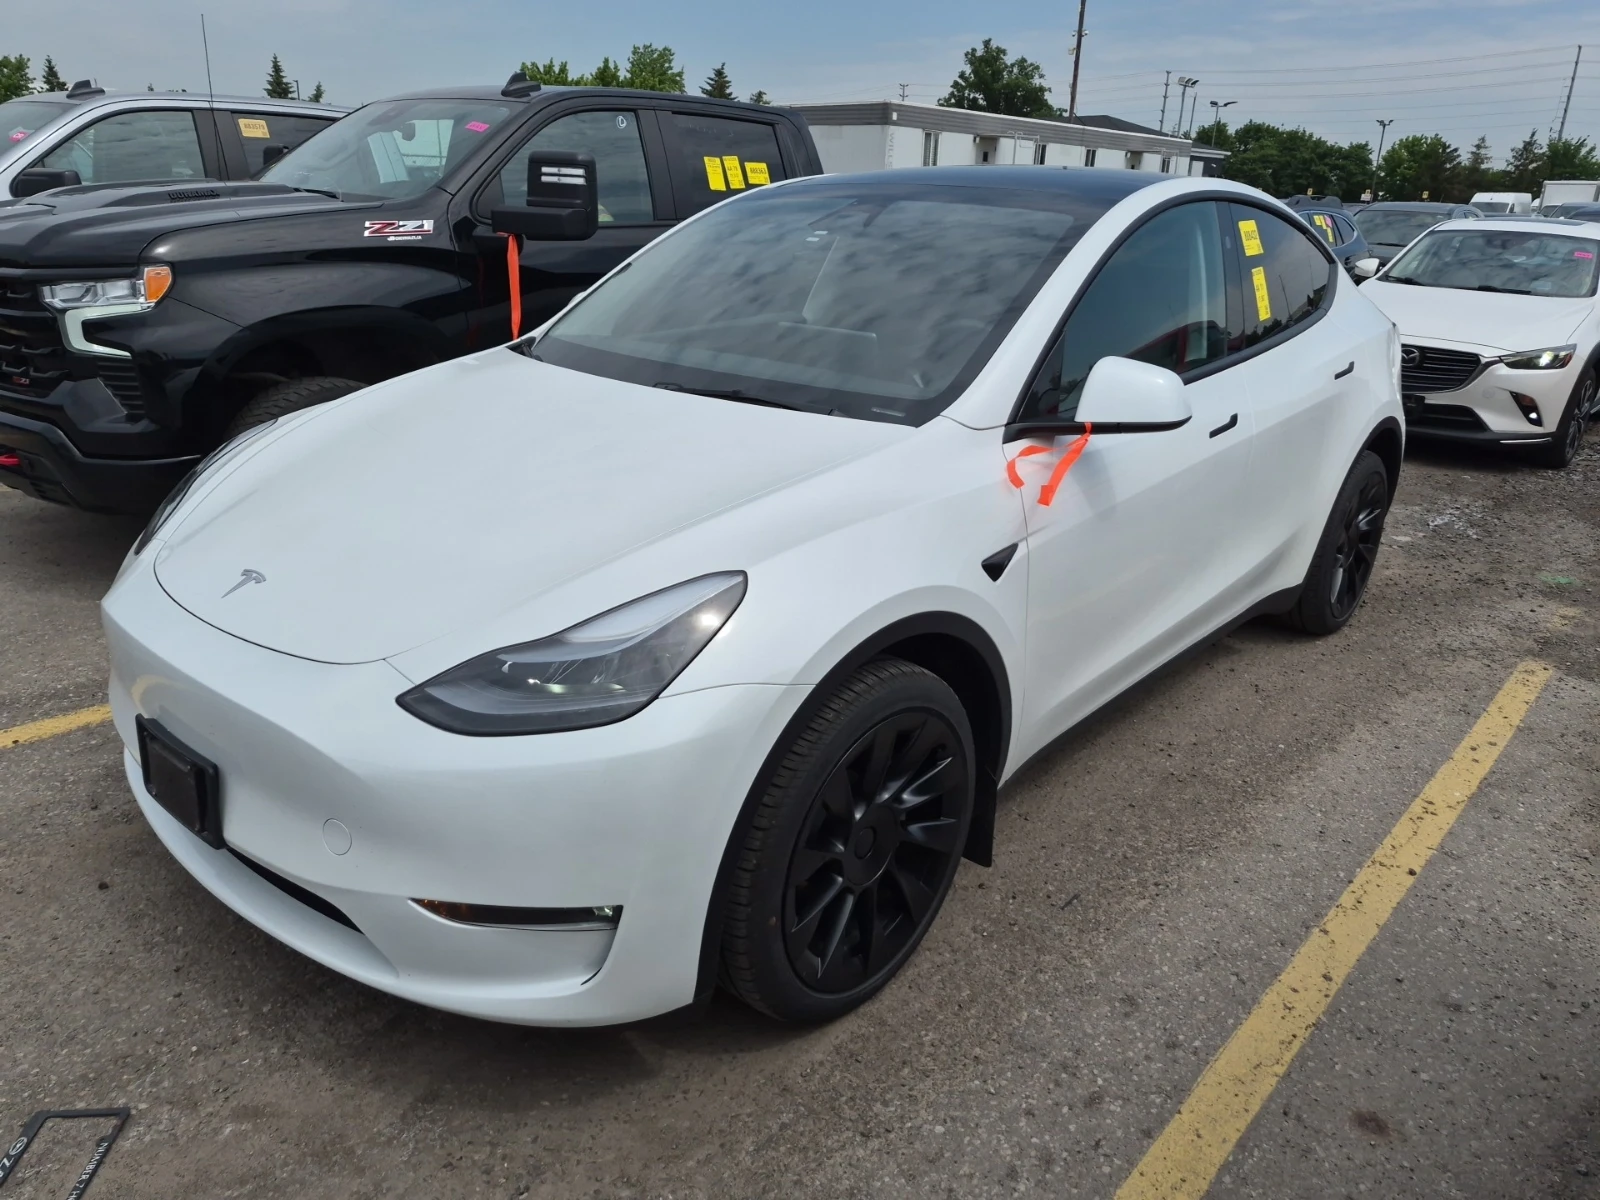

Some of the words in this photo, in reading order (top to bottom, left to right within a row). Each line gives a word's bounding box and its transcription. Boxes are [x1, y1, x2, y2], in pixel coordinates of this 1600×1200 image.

[168, 189, 220, 200] DURAMAX
[363, 219, 434, 237] Z71
[79, 1142, 109, 1181] NUMBER
